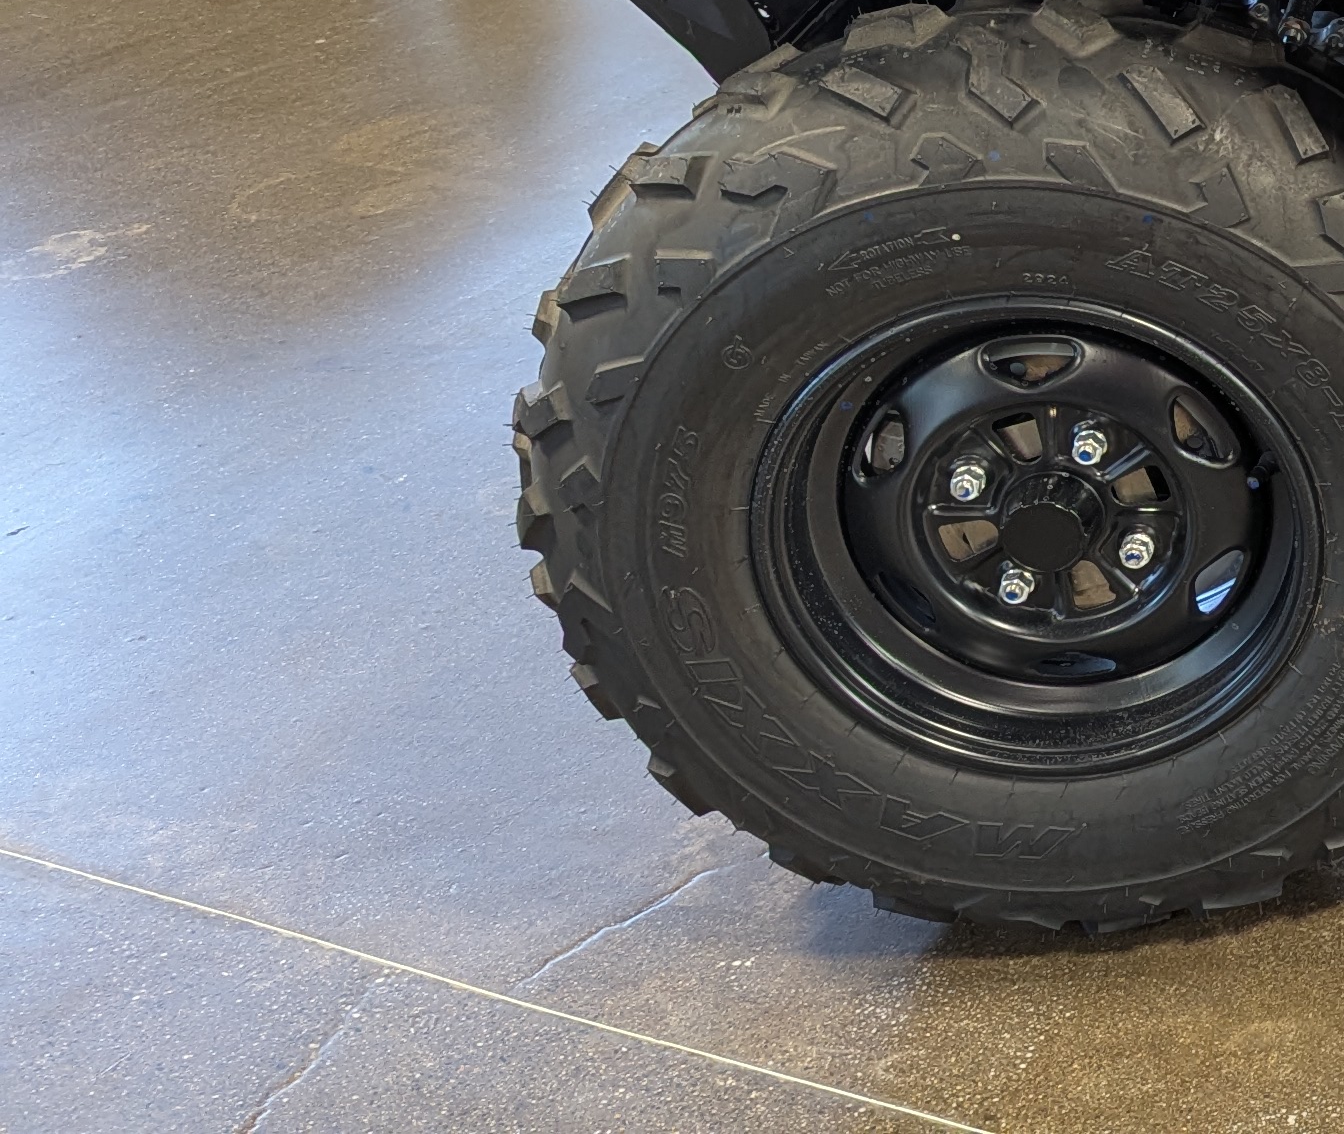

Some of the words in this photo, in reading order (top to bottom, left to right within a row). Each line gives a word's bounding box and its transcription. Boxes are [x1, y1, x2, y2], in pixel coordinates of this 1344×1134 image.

[825, 277, 852, 297] NOT
[854, 262, 882, 283] FOR
[883, 247, 941, 274] HIGHWAY
[859, 234, 915, 262] ROTATION
[661, 584, 1077, 859] MAXXIS
